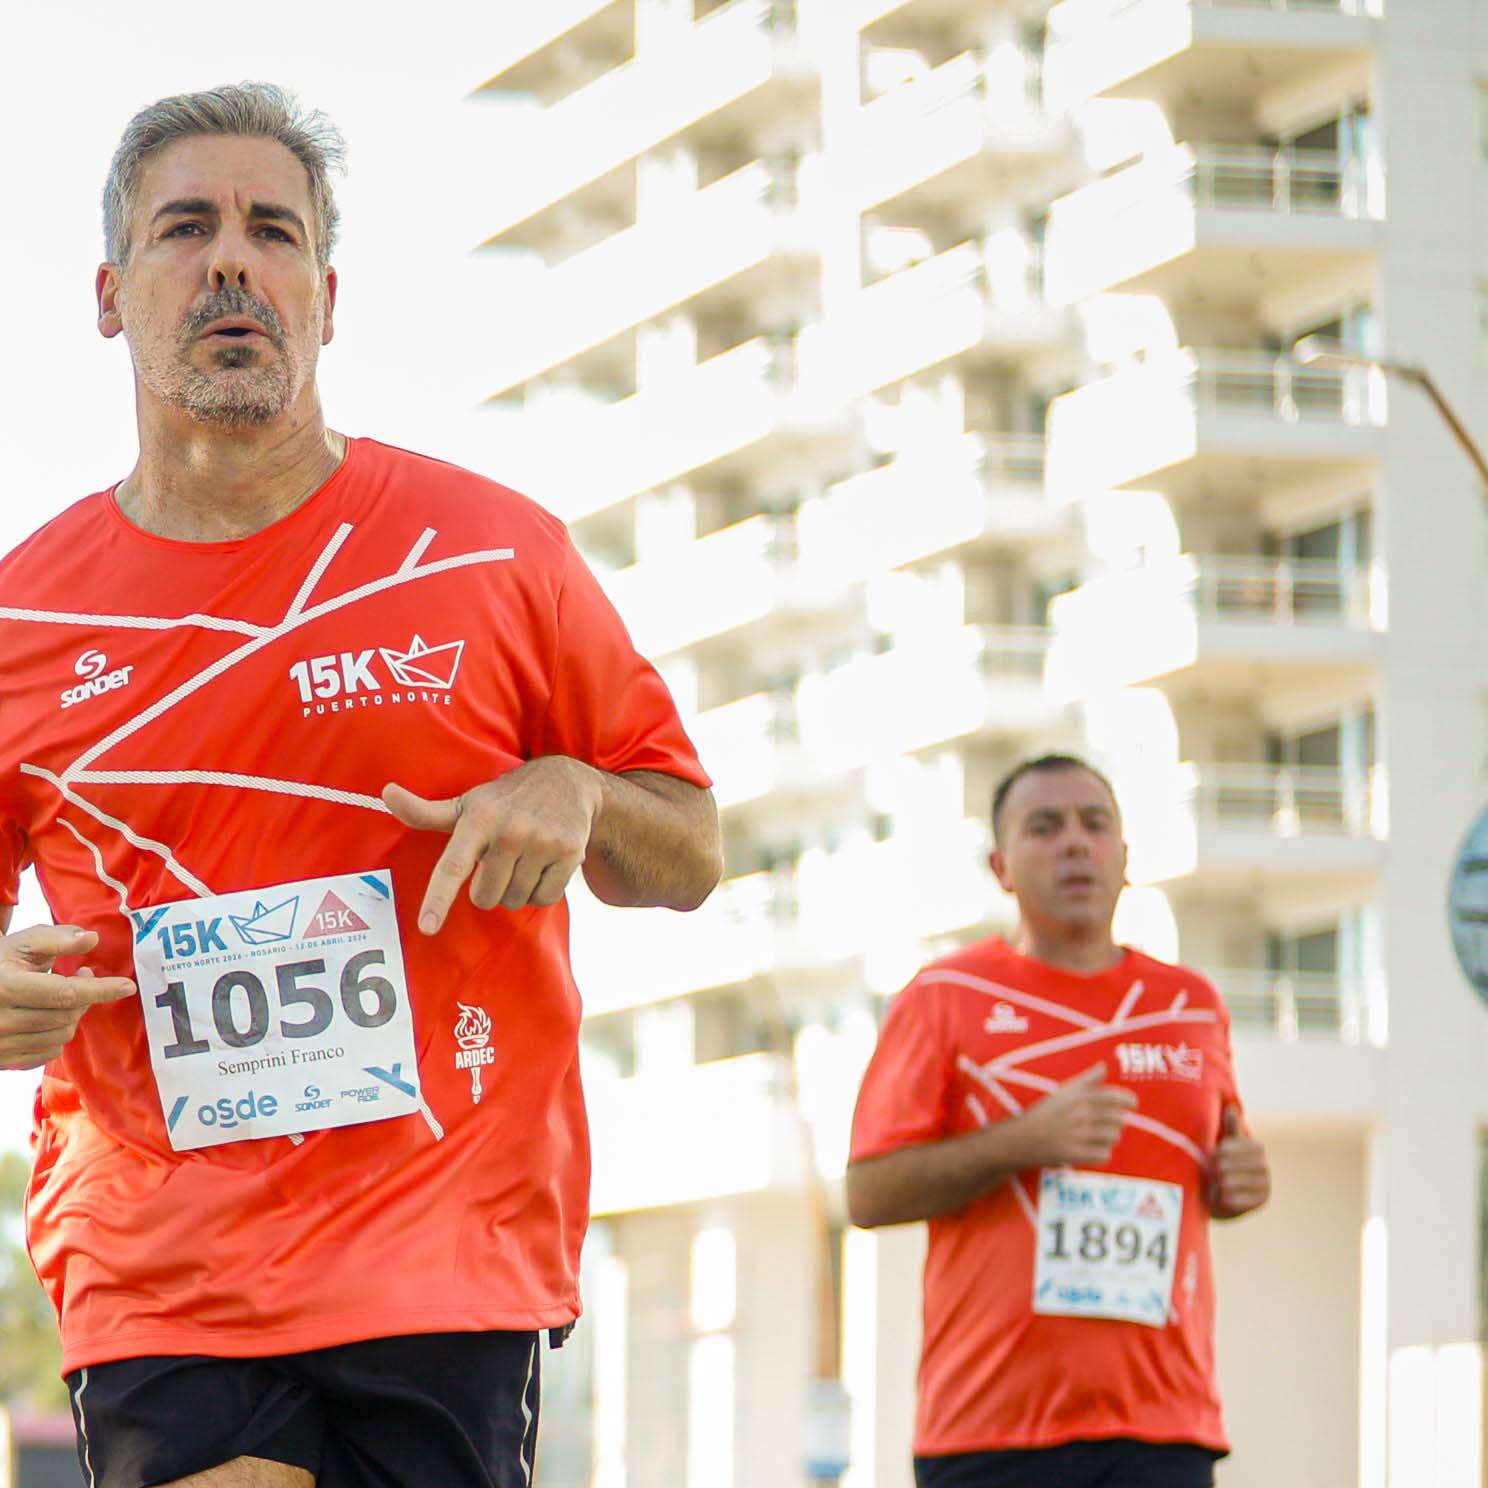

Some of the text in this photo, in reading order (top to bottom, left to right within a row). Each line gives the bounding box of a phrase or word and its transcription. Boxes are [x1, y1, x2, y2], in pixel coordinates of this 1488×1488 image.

[289, 649, 382, 703] 15K
[303, 691, 452, 718] PUERTO NORTE
[314, 908, 354, 930] 15K
[156, 916, 228, 960] 15K
[161, 961, 192, 972] PUERTO
[194, 956, 221, 967] NORTE
[154, 949, 397, 1059] 1056
[218, 1047, 345, 1077] Semprini Franco
[455, 1046, 495, 1069] ARDEC
[1044, 1218, 1169, 1273] 1894
